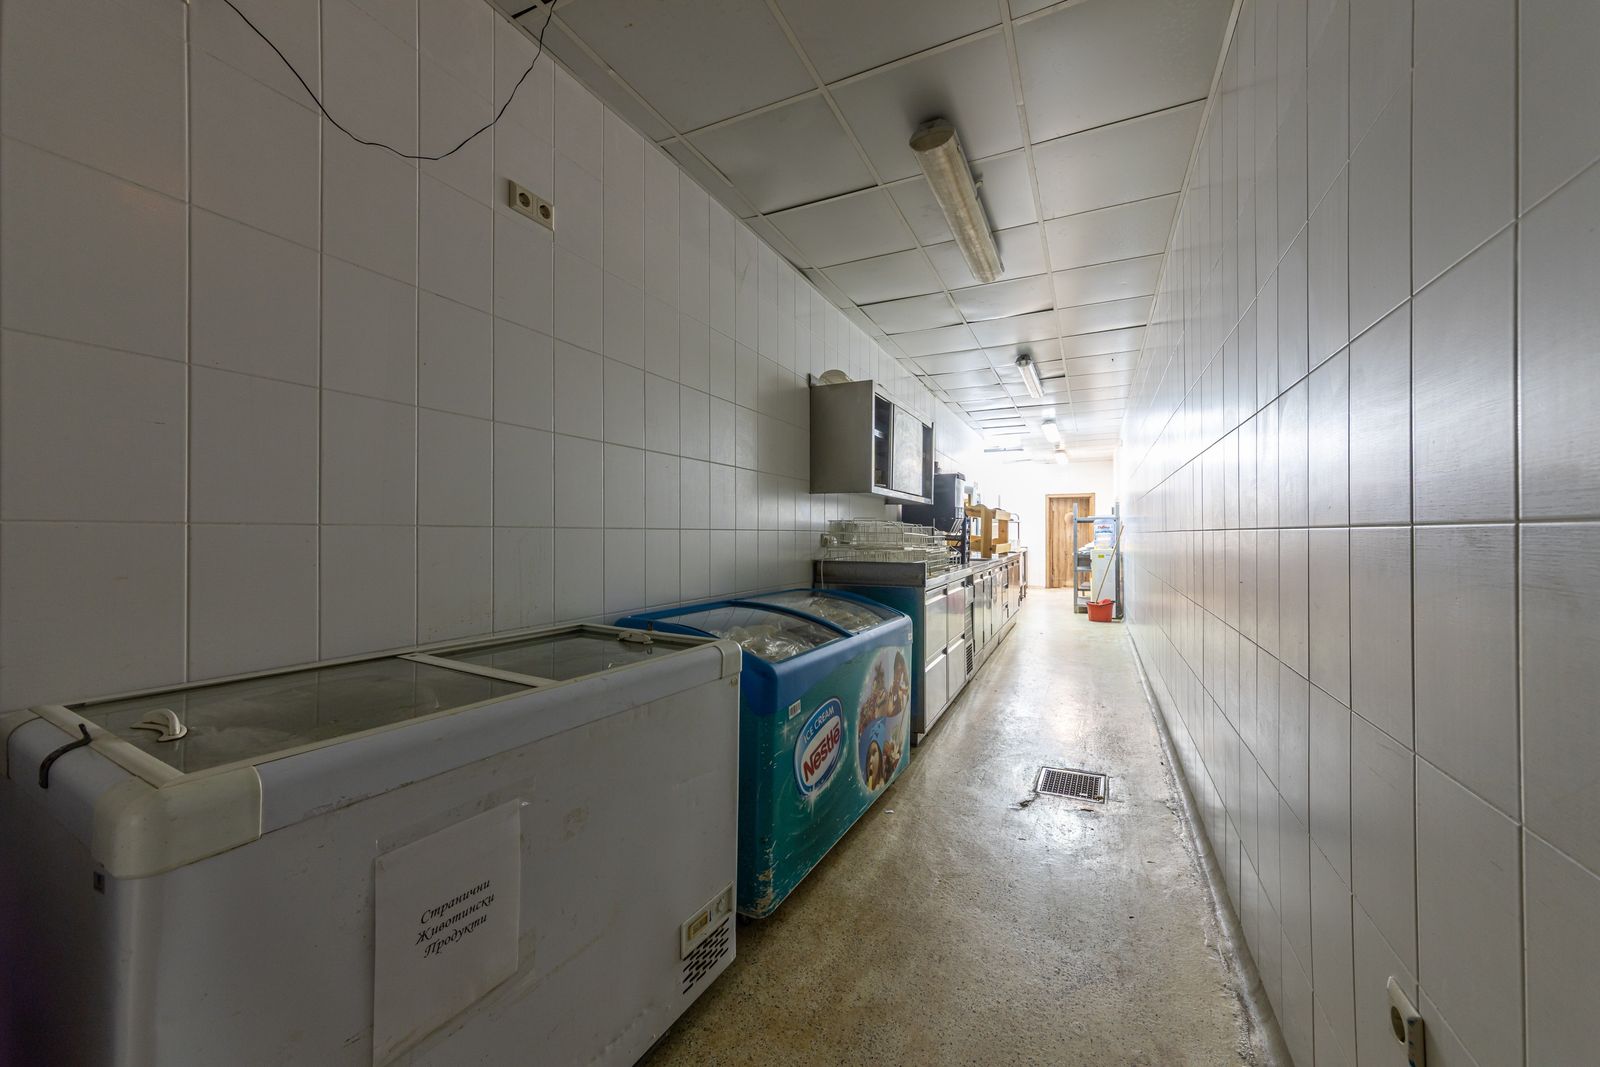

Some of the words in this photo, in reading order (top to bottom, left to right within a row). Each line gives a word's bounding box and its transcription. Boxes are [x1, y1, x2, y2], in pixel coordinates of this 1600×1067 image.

[804, 728, 814, 744] ICE
[814, 705, 835, 730] CREAM
[415, 894, 495, 945] Животински
[420, 880, 490, 924] Странични
[423, 914, 487, 958] Продукти
